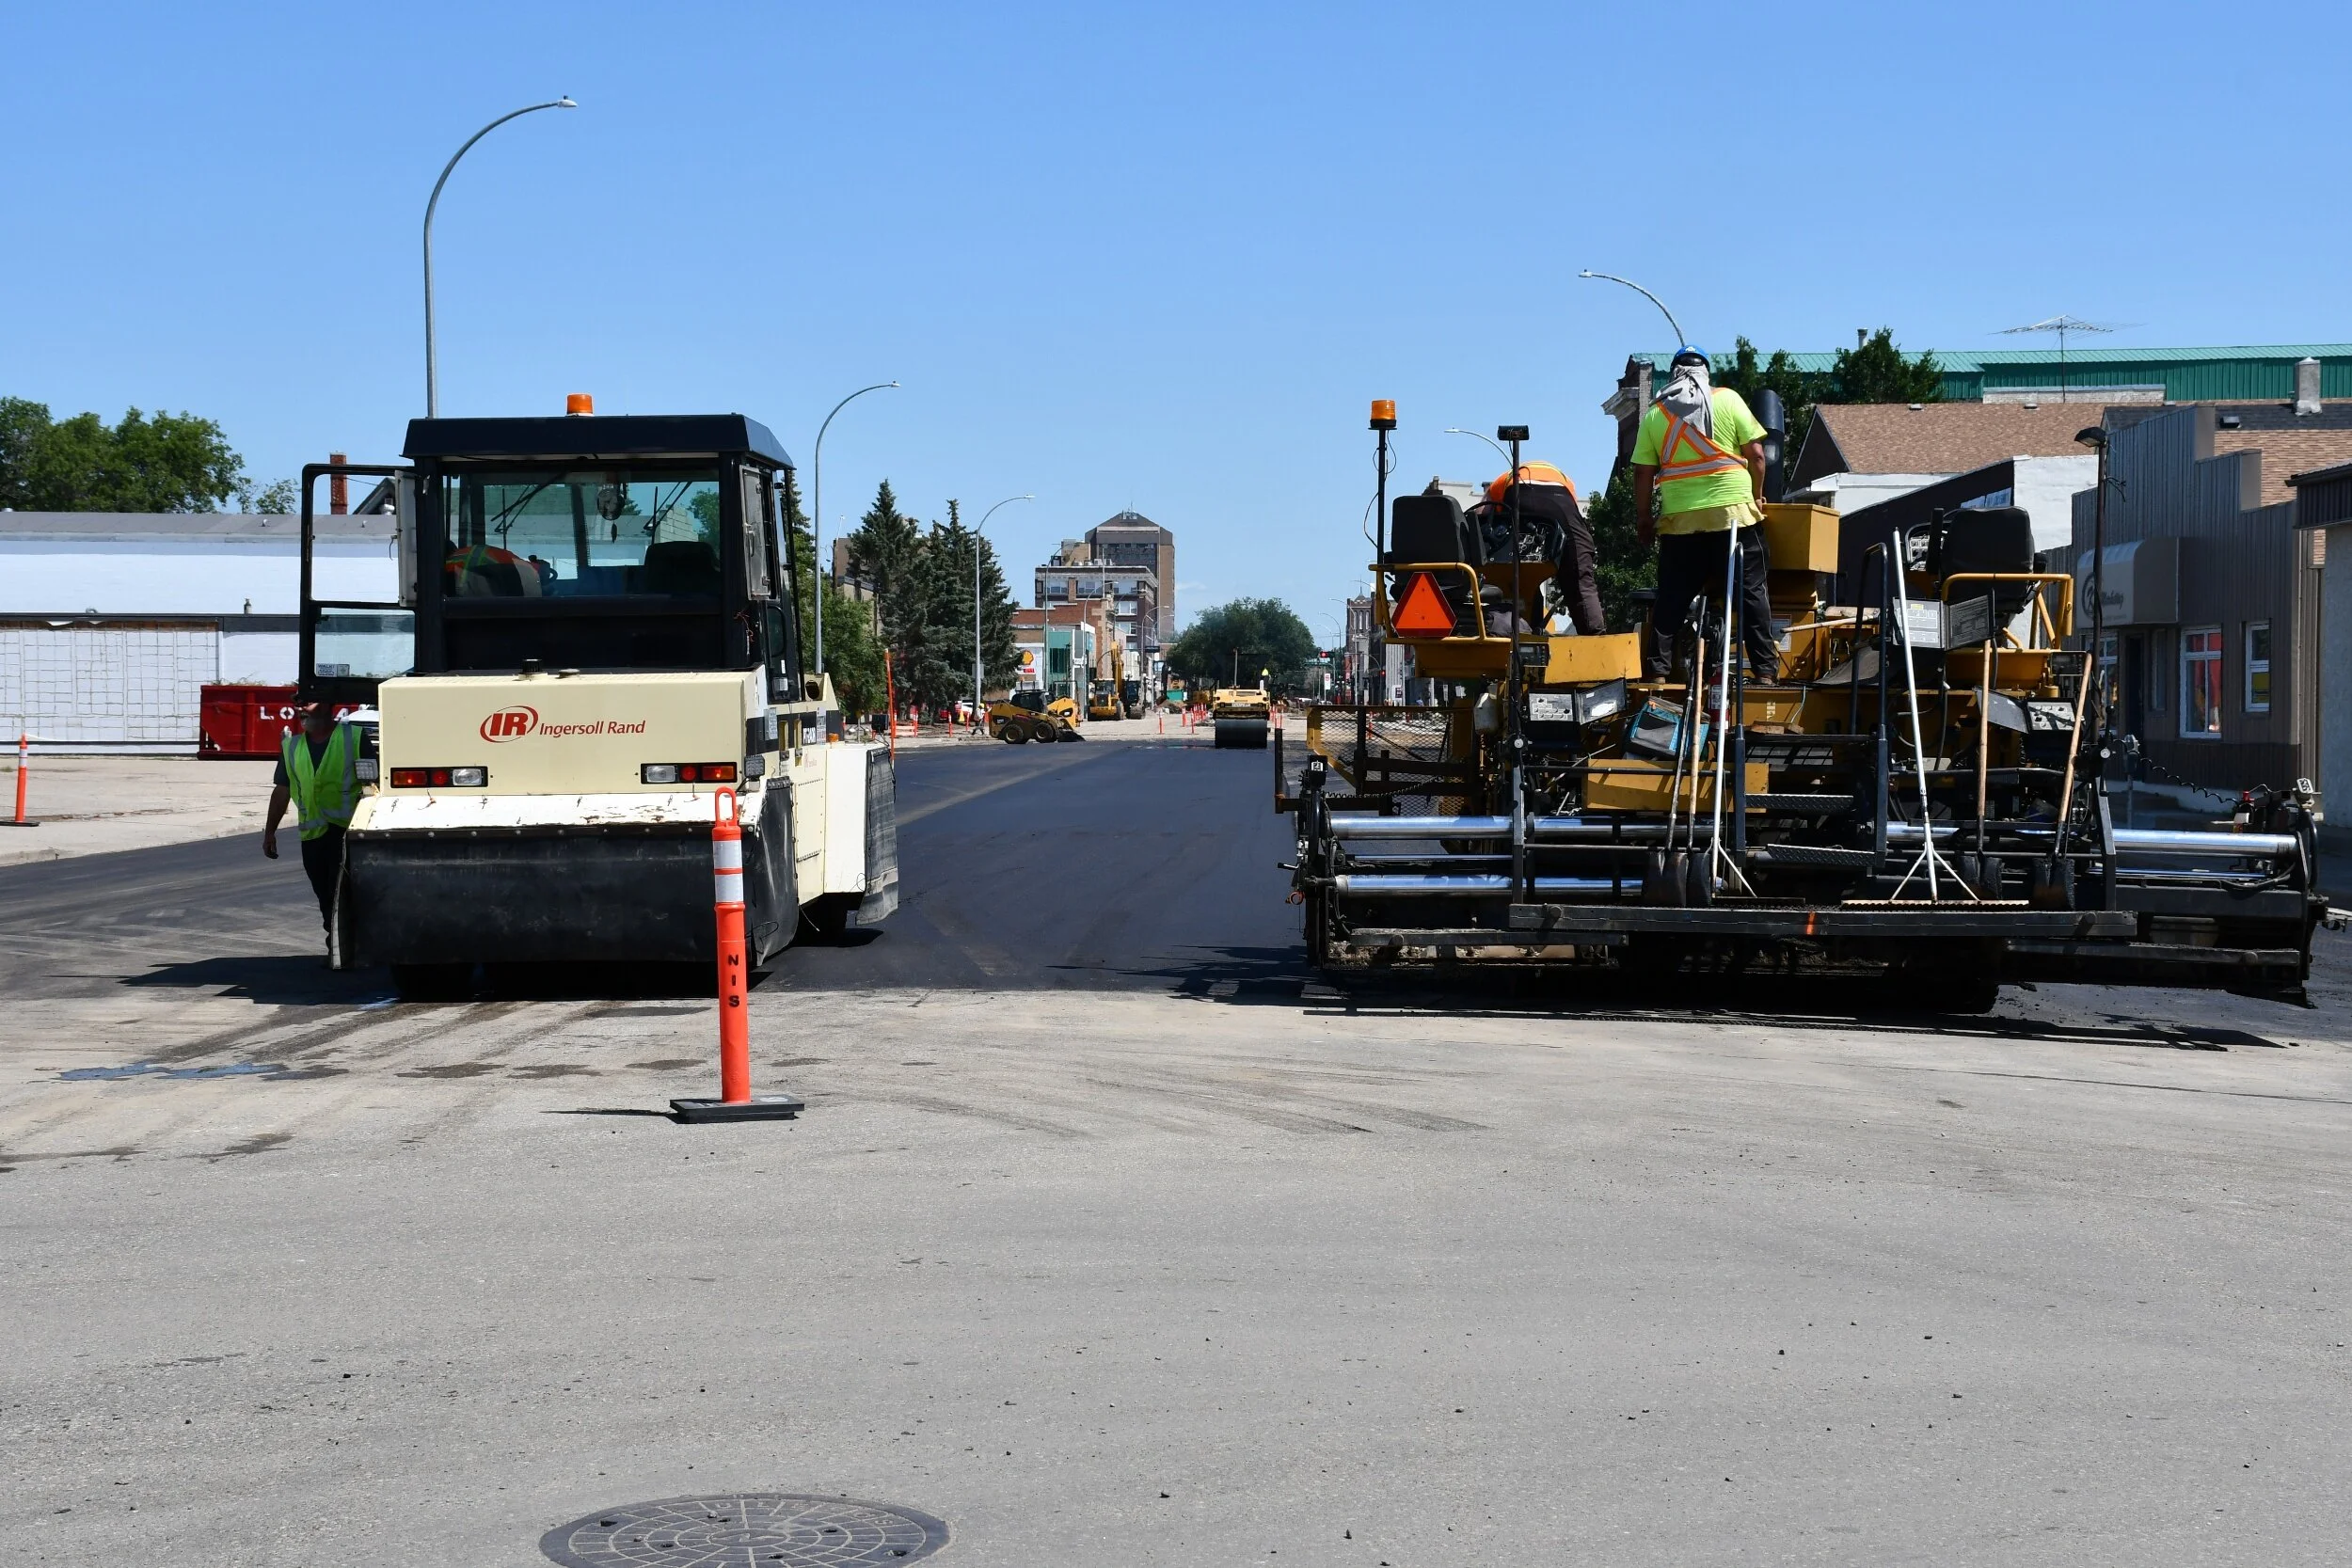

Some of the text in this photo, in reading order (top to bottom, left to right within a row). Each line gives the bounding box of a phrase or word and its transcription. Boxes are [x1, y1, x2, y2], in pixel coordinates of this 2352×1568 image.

[489, 713, 529, 736] IR
[539, 721, 646, 738] Ingersoll Rand
